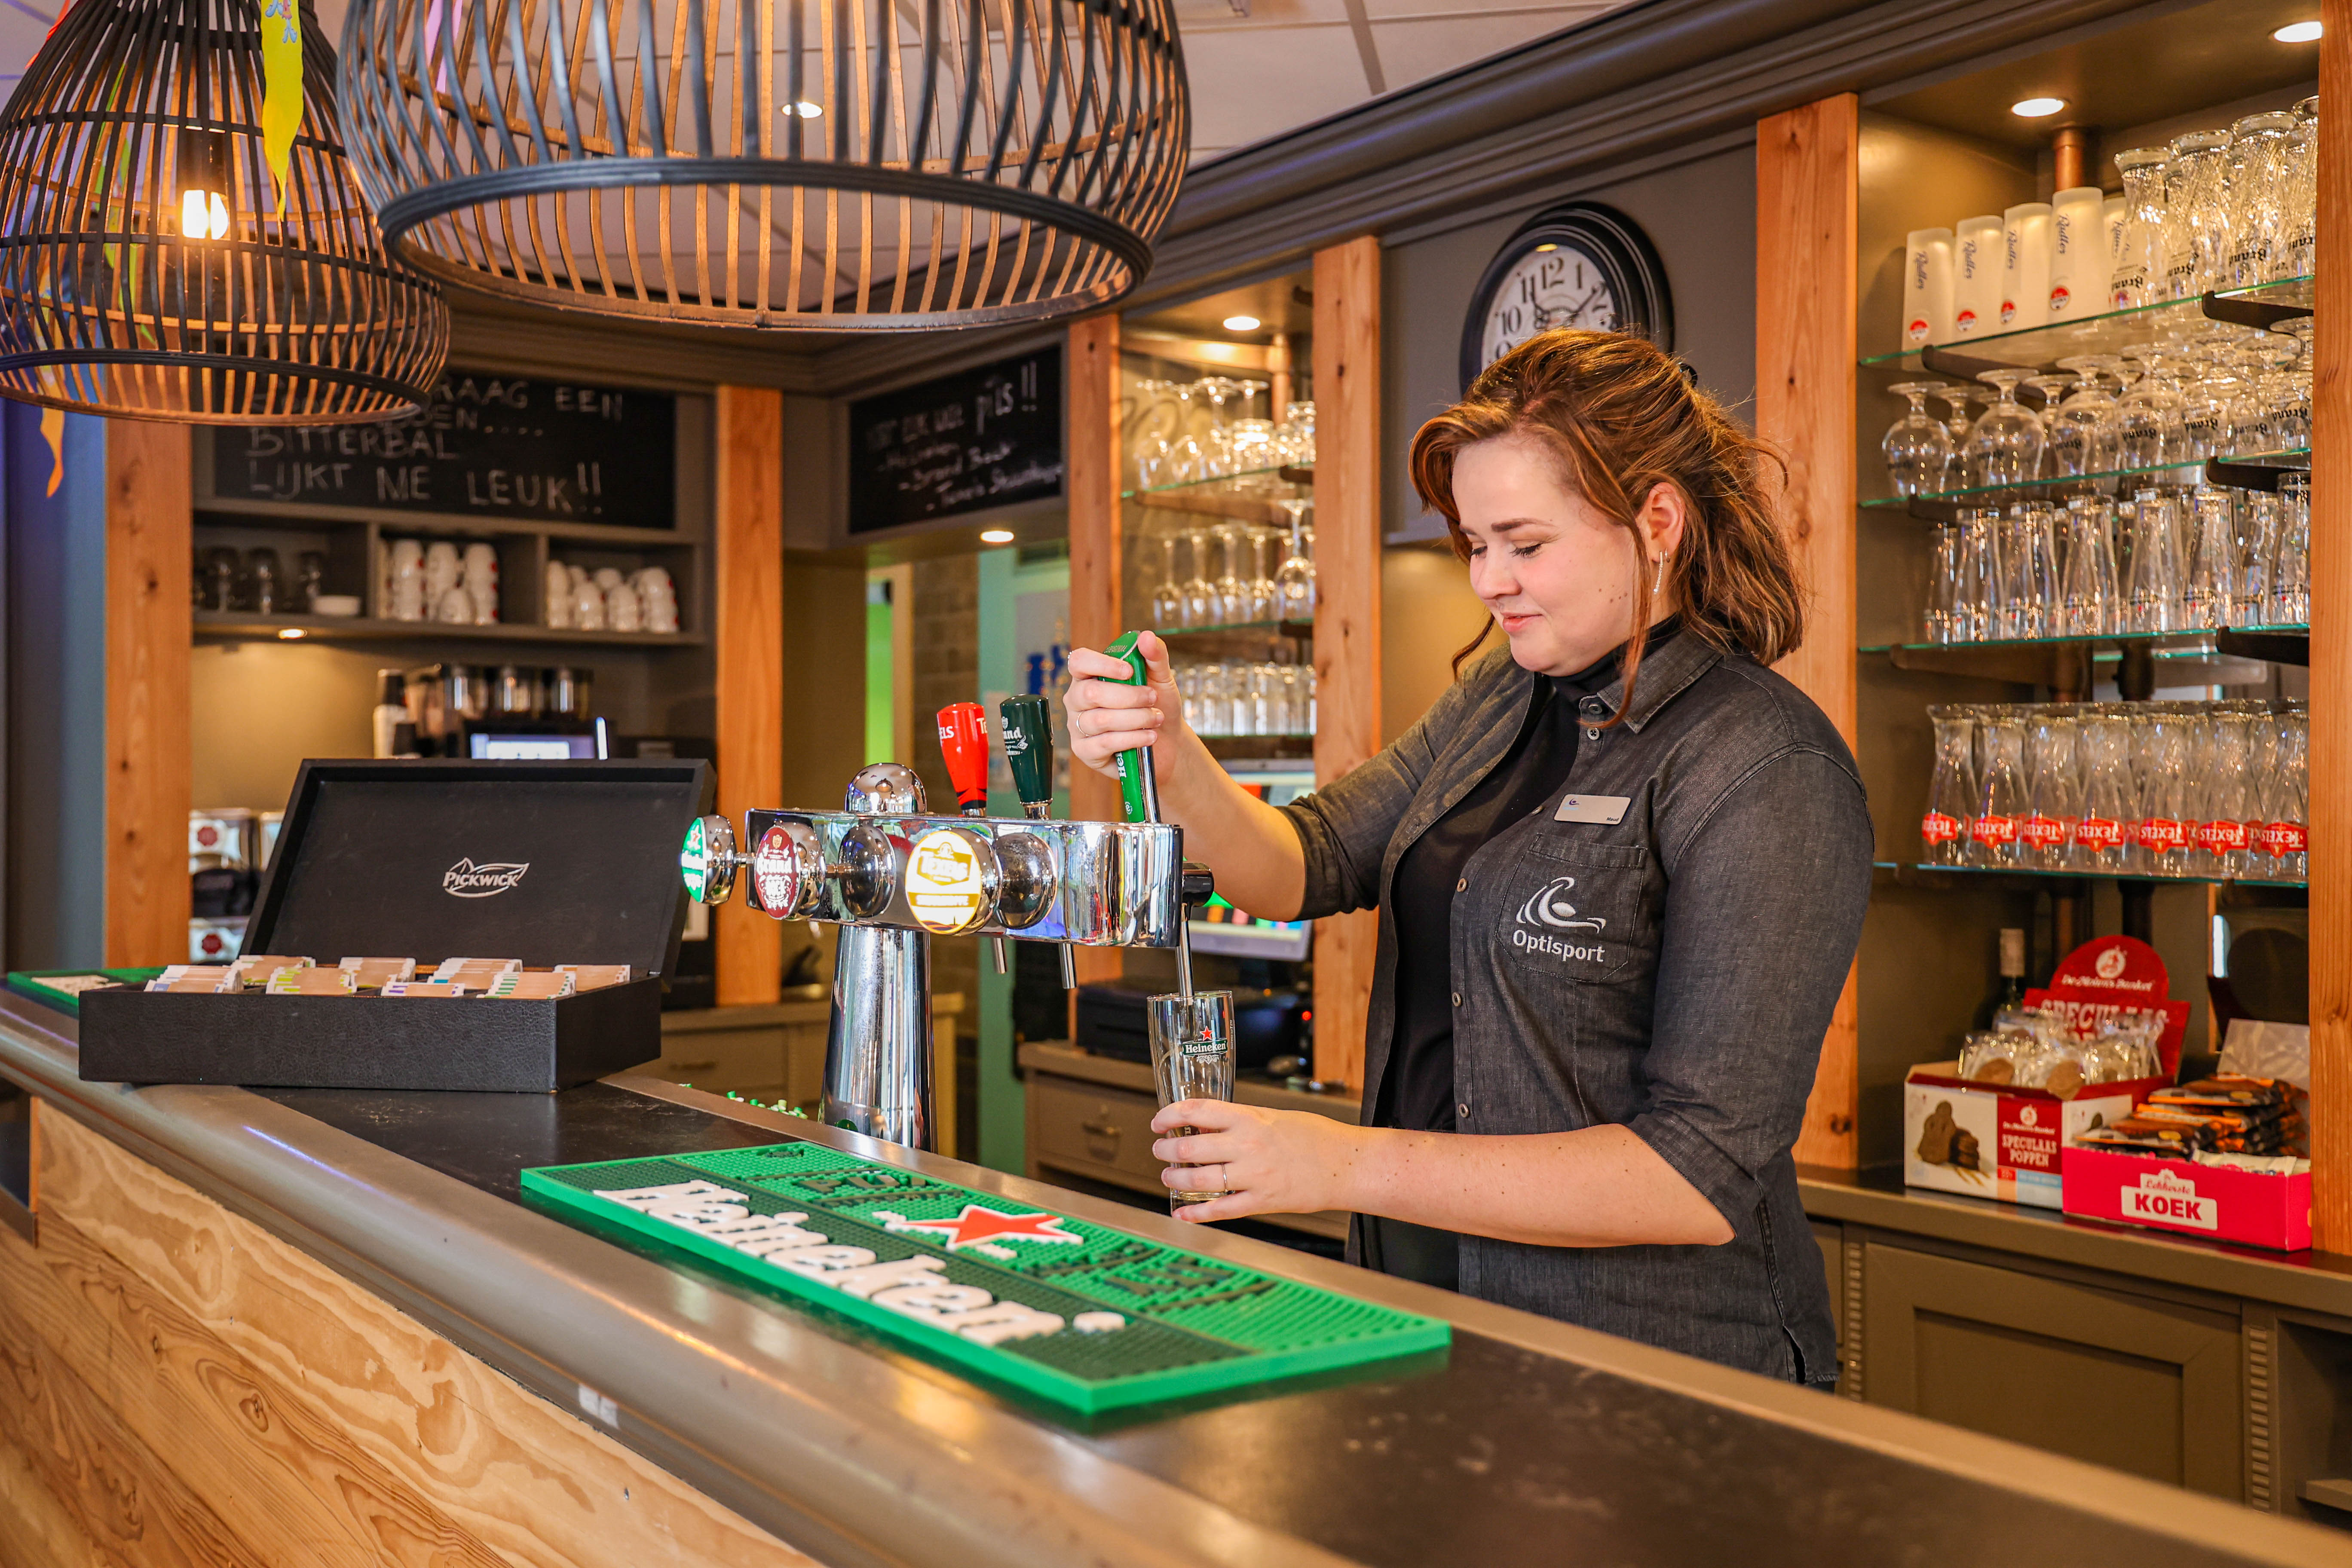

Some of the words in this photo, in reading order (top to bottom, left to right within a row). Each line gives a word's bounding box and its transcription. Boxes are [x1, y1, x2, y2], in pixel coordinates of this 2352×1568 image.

[1541, 257, 1564, 289] 12
[1575, 261, 1583, 289] 1
[1522, 275, 1536, 303] 11
[1501, 306, 1522, 336] 10
[555, 386, 623, 423] EEN
[244, 427, 460, 460] BITTERBAL
[2078, 824, 2121, 844] TEXELS
[2140, 826, 2185, 844] TEXELS
[2200, 826, 2245, 846] TEXELS
[442, 871, 518, 887] PICKWICK
[1513, 929, 1605, 962] Optisport
[1185, 1042, 1226, 1054] Heineken
[2002, 1133, 2057, 1155] SPECULAAS
[2009, 1148, 2049, 1167] POPPEN
[2135, 1192, 2202, 1221] KOEK
[593, 1179, 1066, 1346] Heineken
